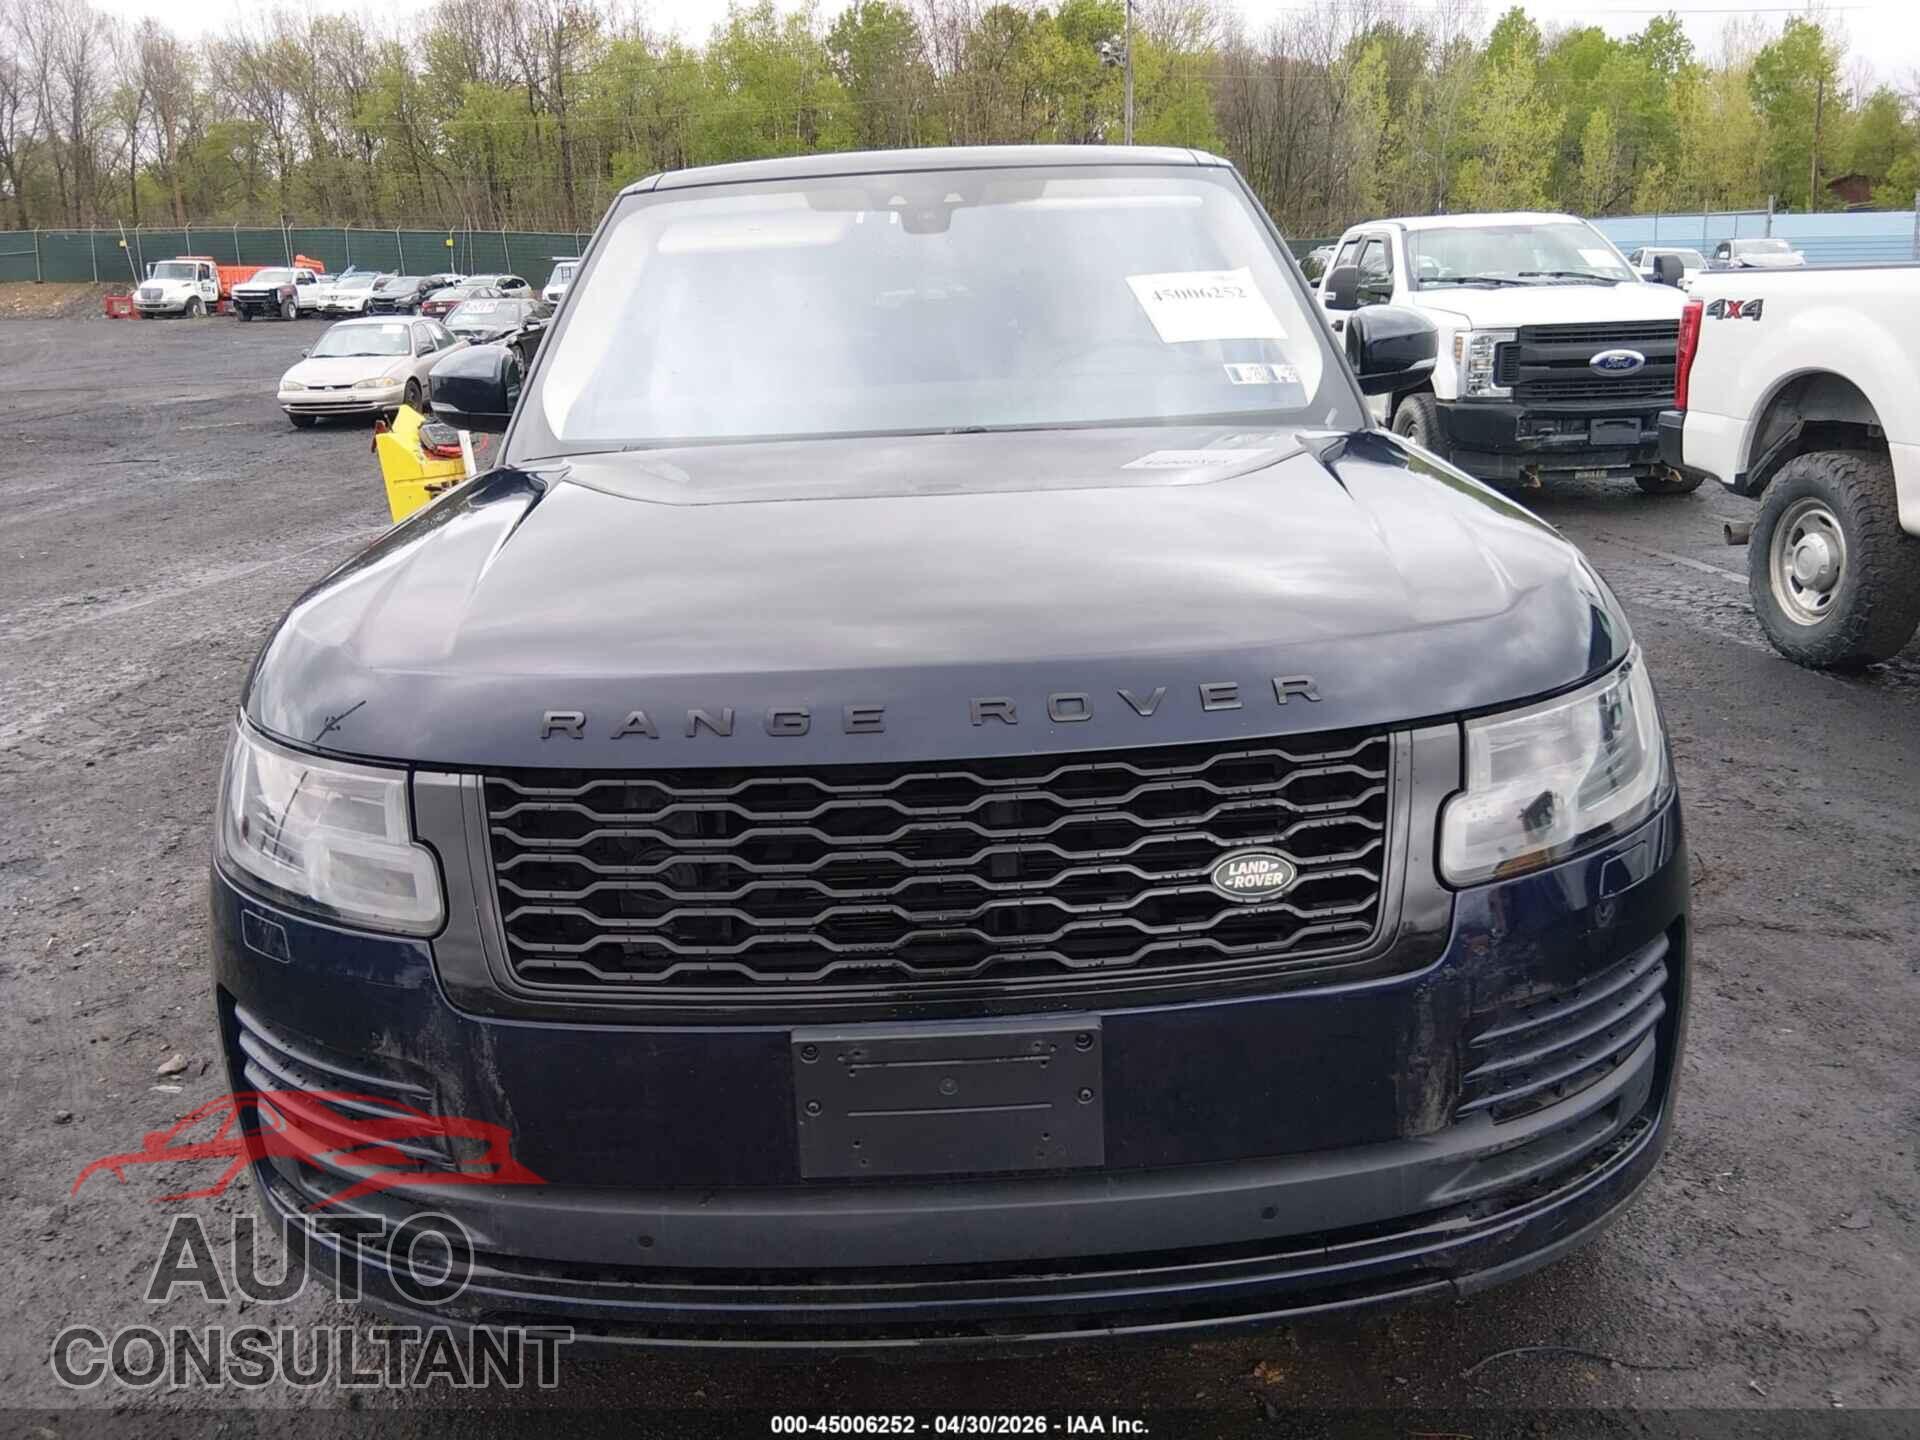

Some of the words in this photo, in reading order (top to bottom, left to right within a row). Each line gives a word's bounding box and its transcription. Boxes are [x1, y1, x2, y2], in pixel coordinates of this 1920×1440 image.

[1152, 285, 1248, 302] 45006252
[540, 704, 887, 740] RANGE
[969, 673, 1323, 727] ROVER
